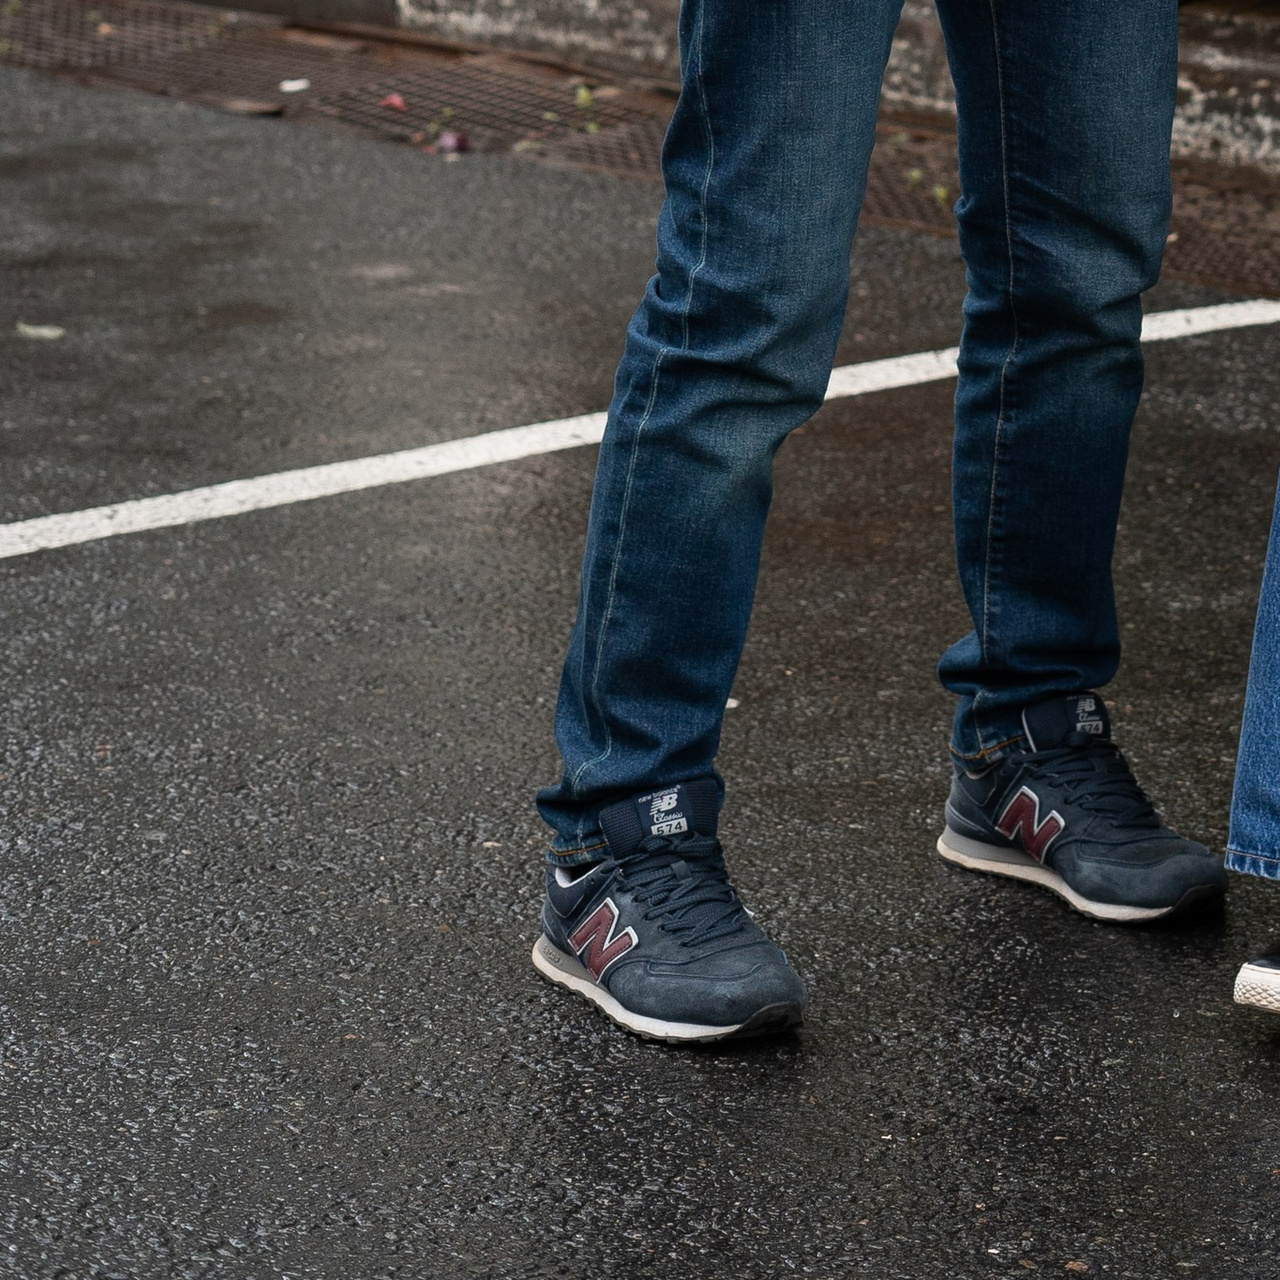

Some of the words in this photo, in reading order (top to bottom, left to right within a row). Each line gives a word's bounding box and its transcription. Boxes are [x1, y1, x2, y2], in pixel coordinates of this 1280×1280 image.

[638, 794, 652, 803] new
[653, 811, 683, 824] Classic
[994, 785, 1066, 864] N
[656, 821, 683, 836] 574
[567, 897, 639, 985] N
